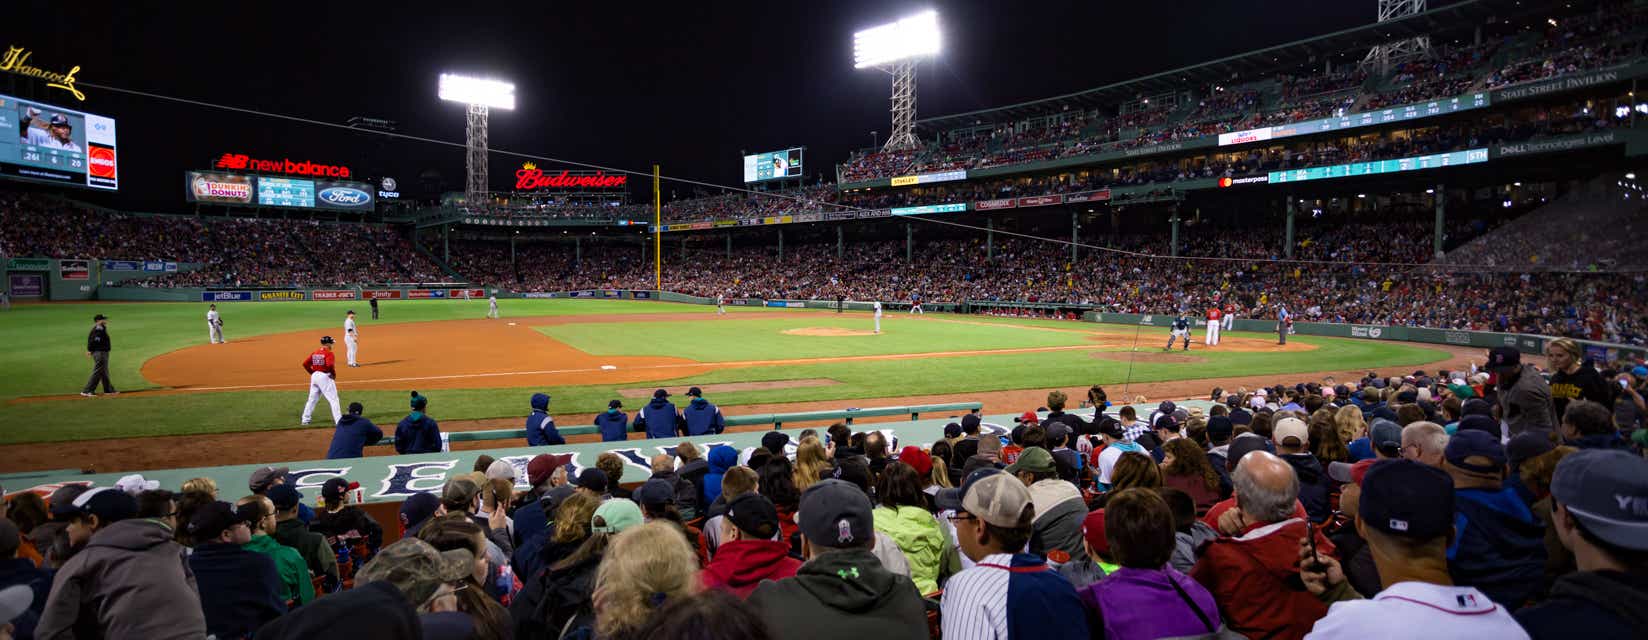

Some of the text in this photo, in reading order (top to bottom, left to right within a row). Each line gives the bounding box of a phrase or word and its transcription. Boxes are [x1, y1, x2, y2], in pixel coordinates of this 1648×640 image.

[0, 45, 85, 101] Hancock
[1501, 72, 1617, 99] STATE STREET PAVILION
[1587, 132, 1614, 145] Level
[250, 159, 283, 172] new
[285, 158, 349, 177] balance
[516, 169, 627, 189] Budweiser
[211, 189, 247, 197] DONUTS
[328, 189, 360, 203] Ford
[379, 191, 400, 199] tyco
[215, 291, 241, 300] jetBlue
